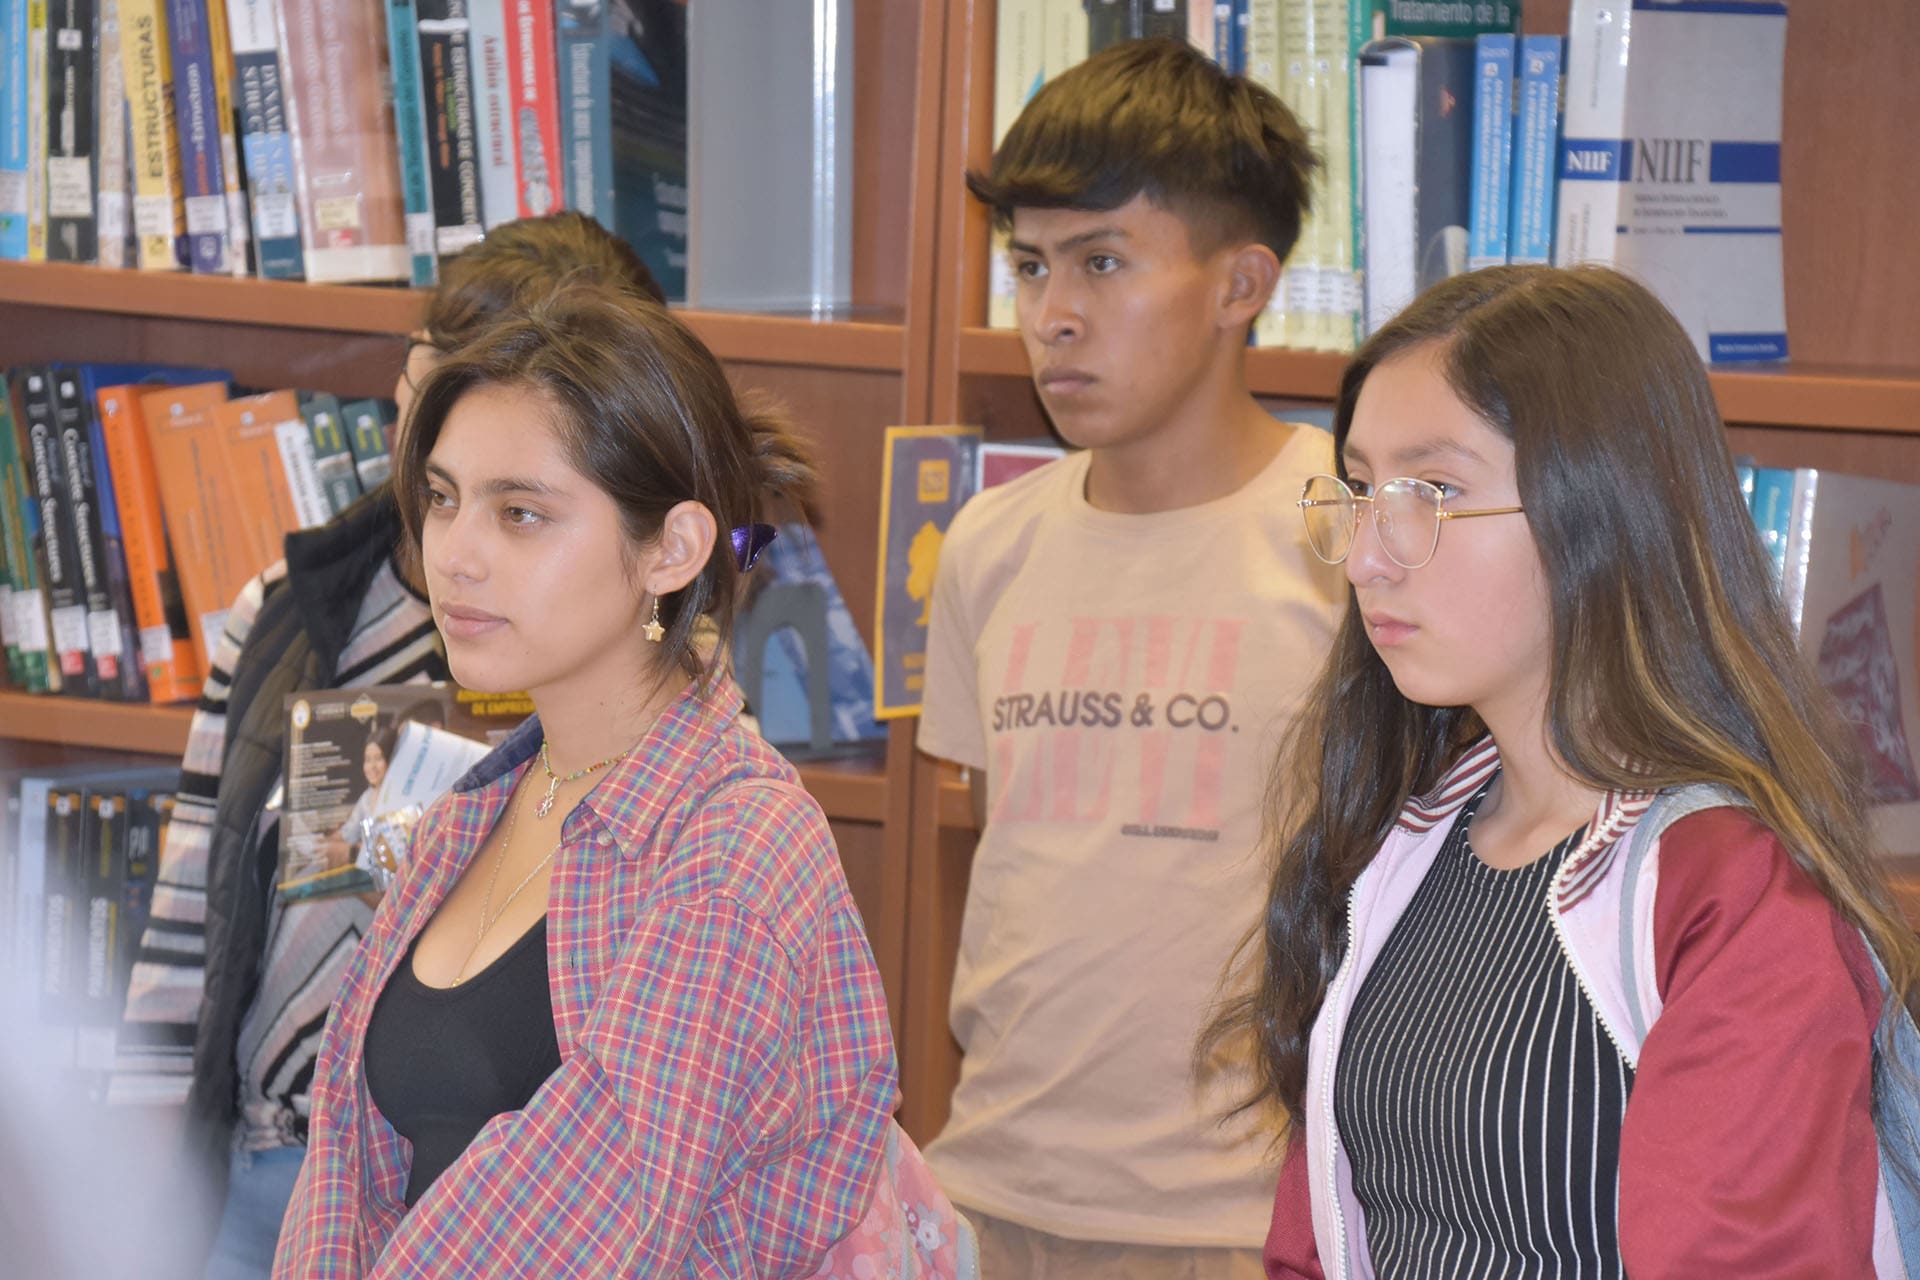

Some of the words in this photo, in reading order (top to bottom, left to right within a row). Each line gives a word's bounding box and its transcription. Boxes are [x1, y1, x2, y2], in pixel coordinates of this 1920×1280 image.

[1476, 2, 1494, 25] de
[136, 15, 162, 178] ESTRUCTURAS
[261, 65, 282, 160] DYNAMICS
[452, 46, 472, 138] ESTRUCTURAS
[458, 140, 473, 159] DE
[1567, 149, 1613, 173] NIIF
[1636, 138, 1705, 184] NIIF
[30, 423, 51, 497] Concrete
[42, 497, 61, 583] Structures
[63, 428, 84, 500] Concrete
[76, 502, 96, 588] Structures
[993, 691, 1123, 732] STRAUSS
[1130, 692, 1156, 728] &
[1166, 692, 1240, 734] CO.
